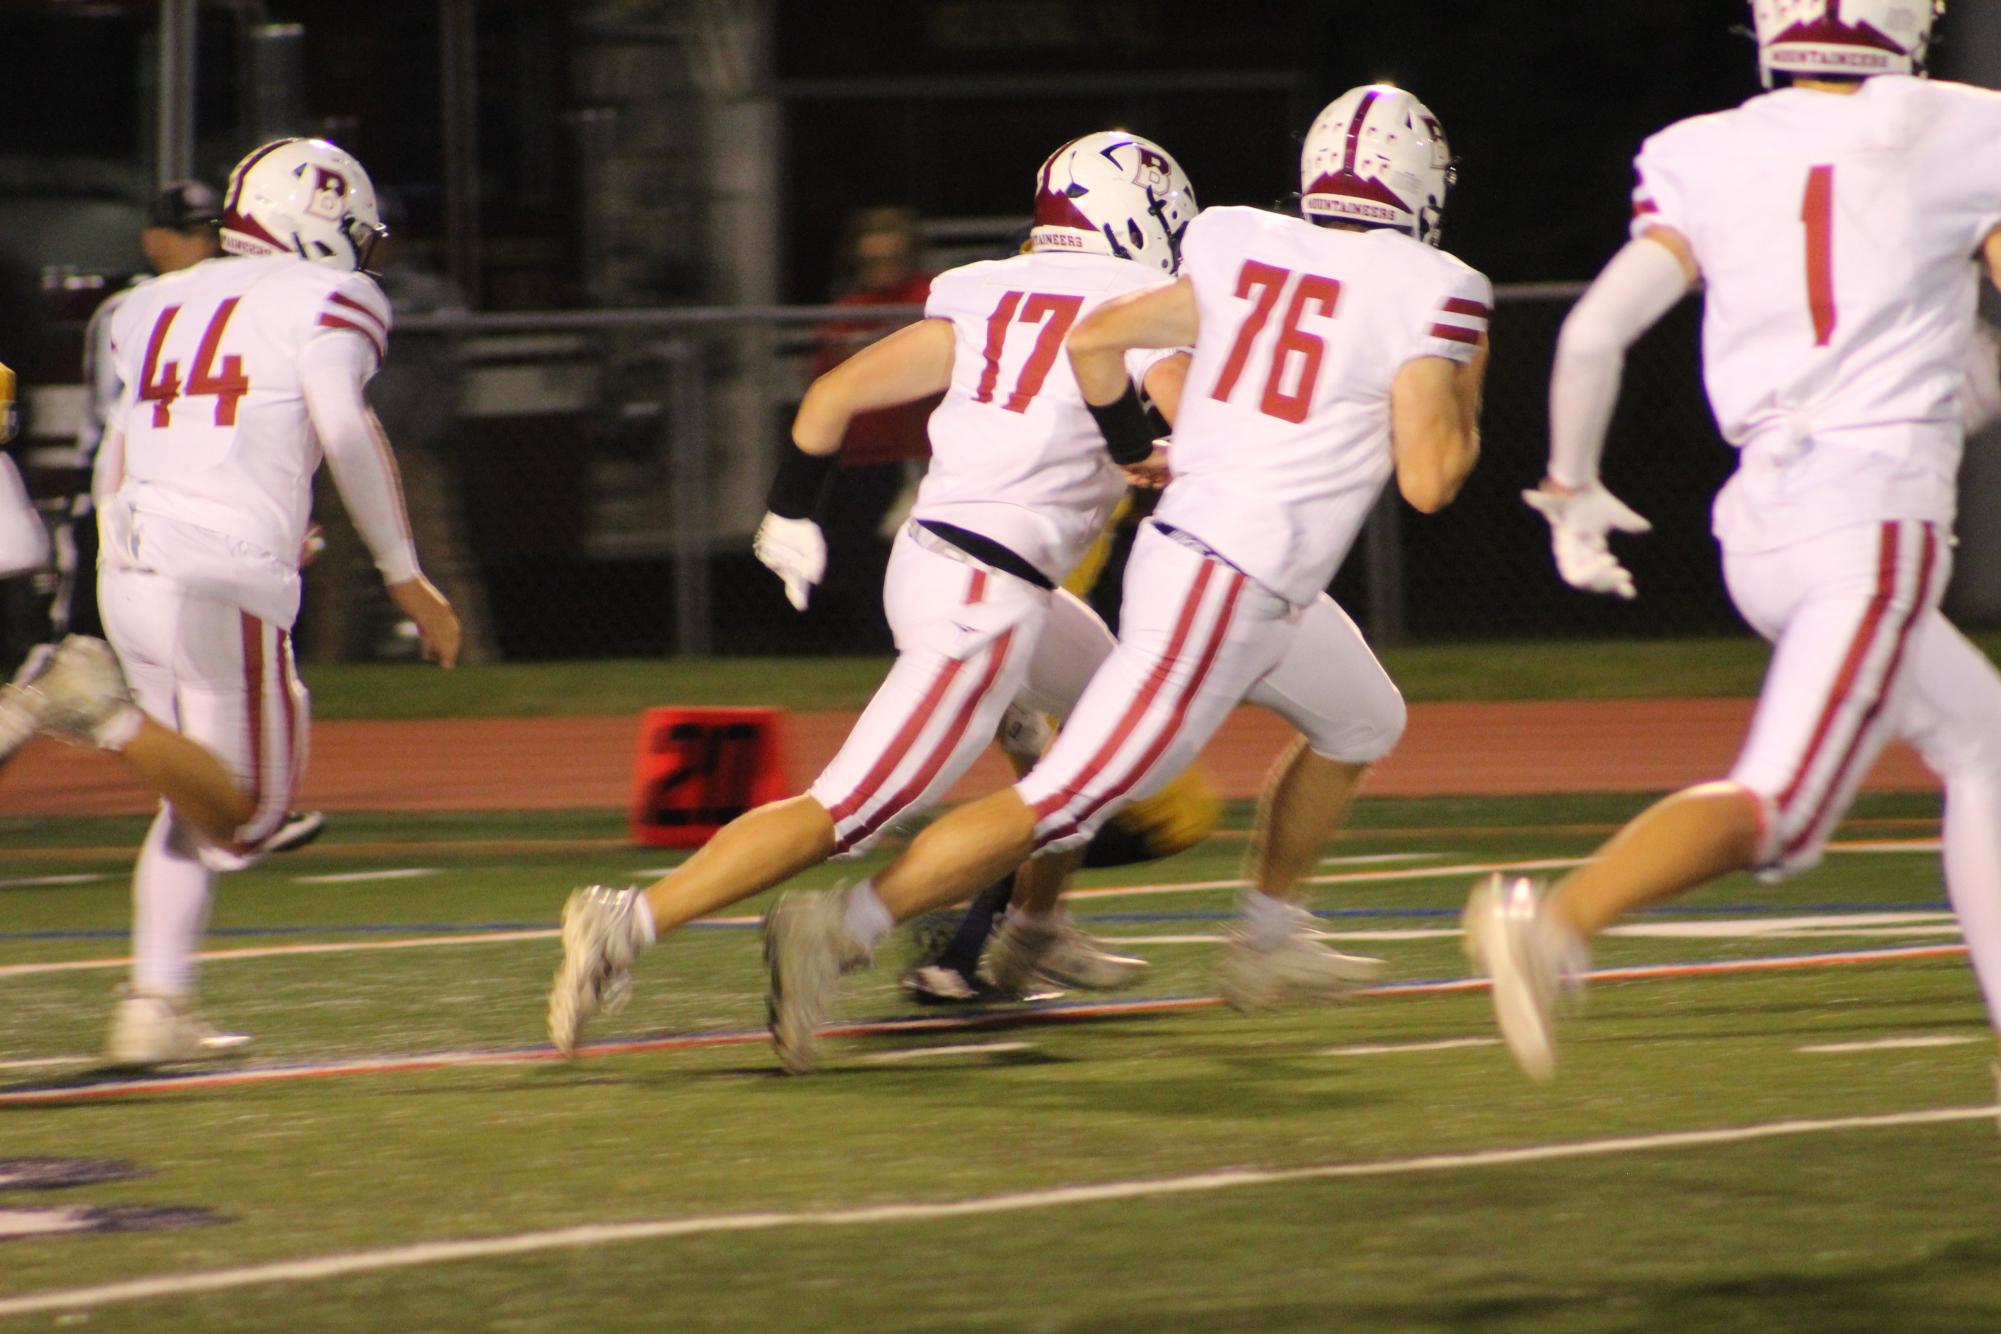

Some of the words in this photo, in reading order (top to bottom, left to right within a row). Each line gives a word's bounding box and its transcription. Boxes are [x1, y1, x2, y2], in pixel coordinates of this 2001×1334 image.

[304, 164, 348, 222] B
[1800, 164, 1836, 346] 1
[138, 295, 248, 429] 44
[971, 290, 1085, 414] 17
[1209, 258, 1341, 424] 76
